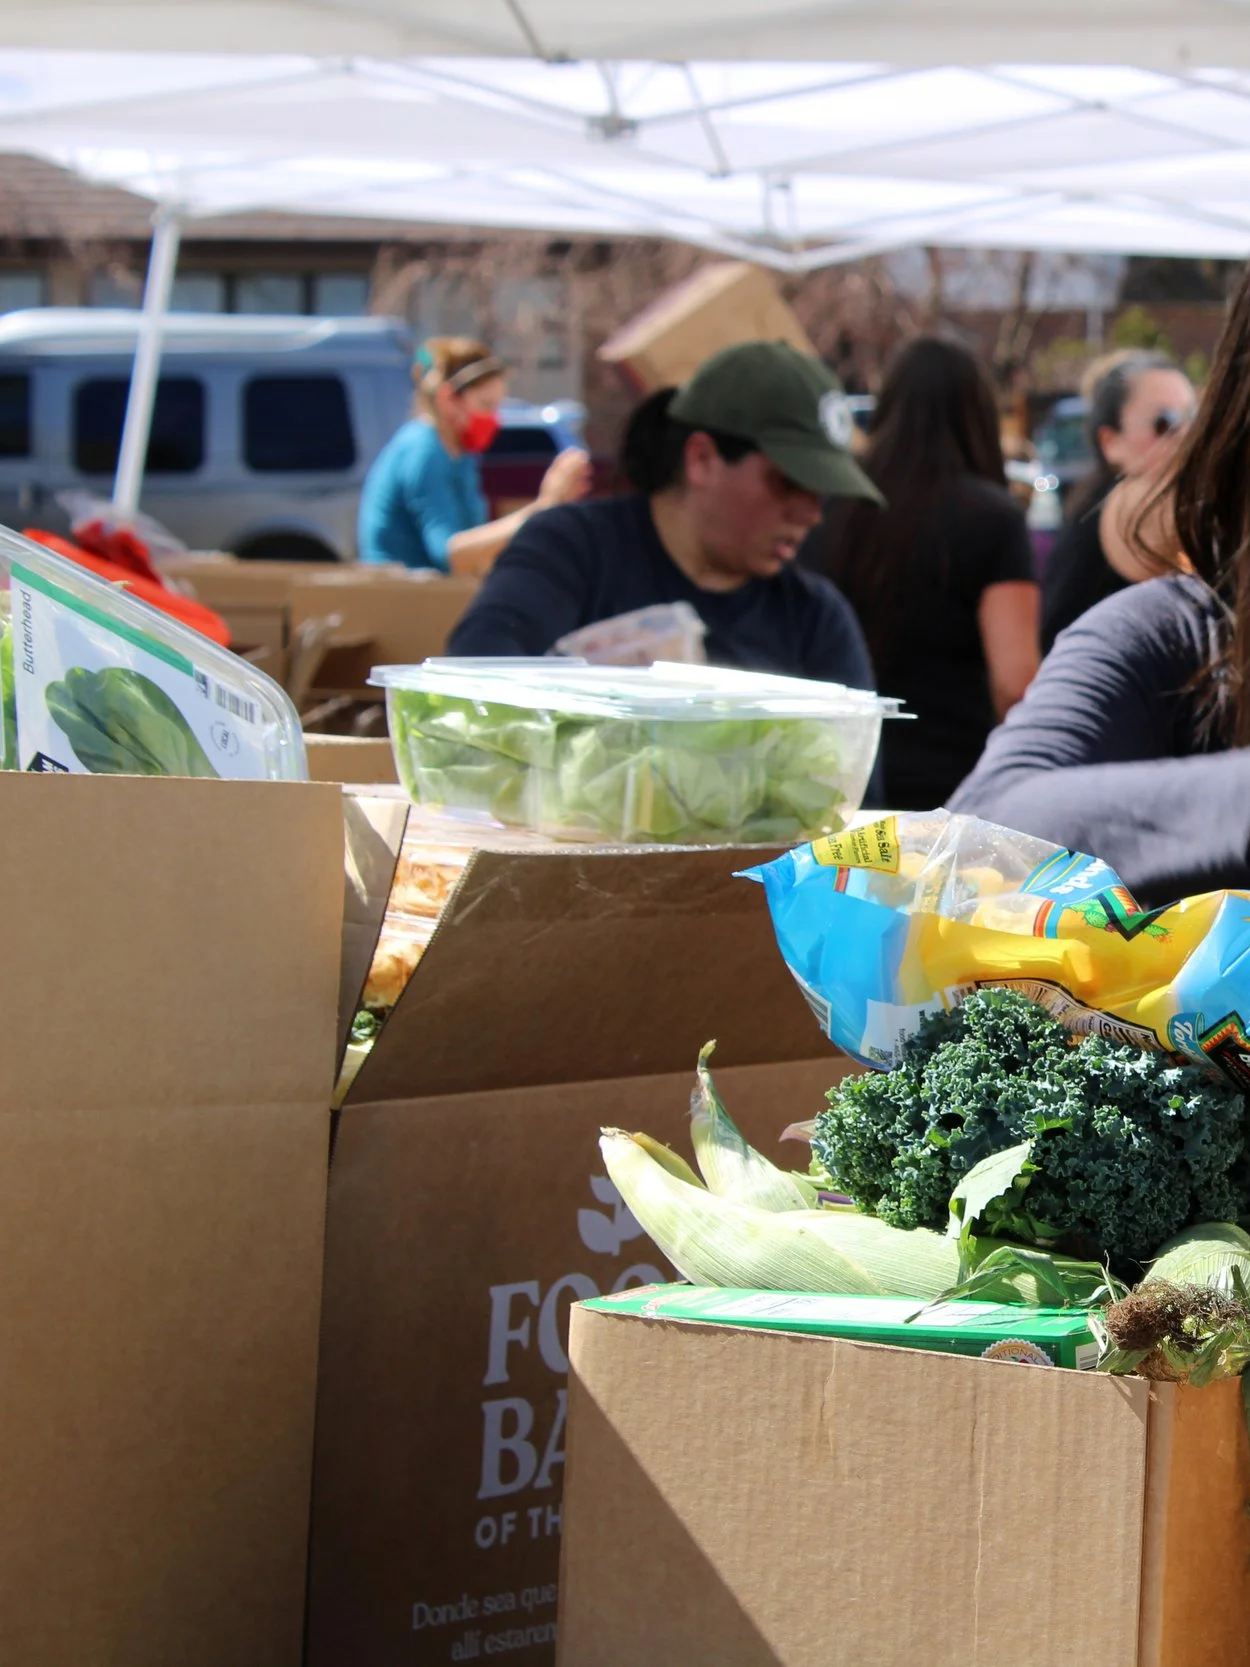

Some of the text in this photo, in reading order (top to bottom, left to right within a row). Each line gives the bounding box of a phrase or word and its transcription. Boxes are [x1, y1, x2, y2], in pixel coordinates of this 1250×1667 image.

[23, 589, 34, 675] Butterhead
[832, 843, 844, 861] Free
[878, 842, 891, 864] Salt
[477, 1388, 568, 1500] BA
[474, 1504, 562, 1549] OF TH
[412, 1592, 480, 1630] Donde
[482, 1589, 517, 1615] sea
